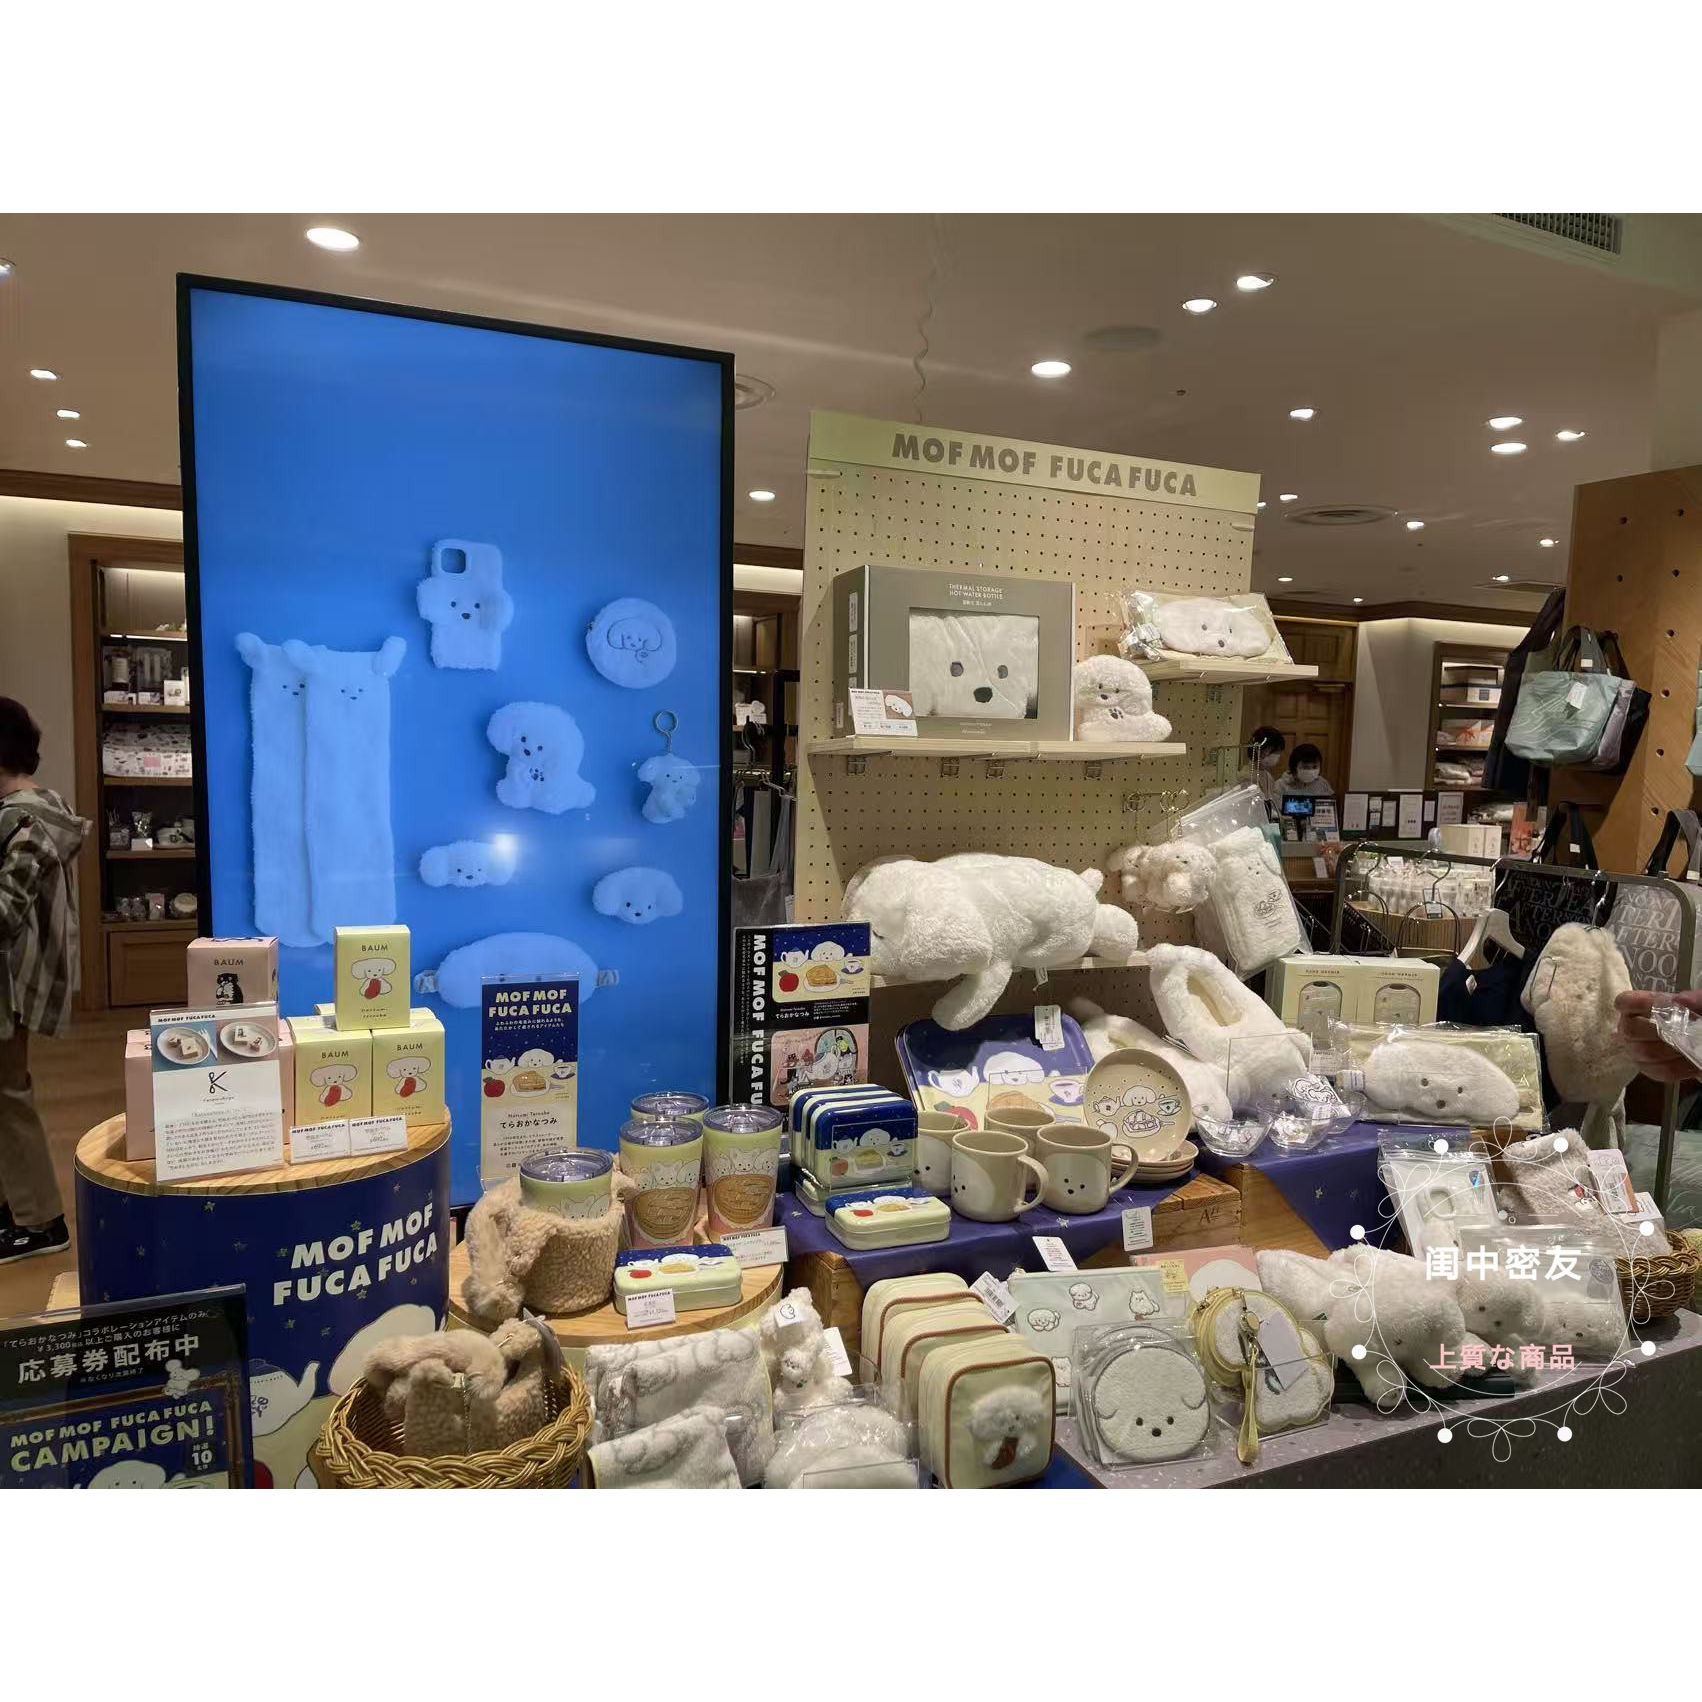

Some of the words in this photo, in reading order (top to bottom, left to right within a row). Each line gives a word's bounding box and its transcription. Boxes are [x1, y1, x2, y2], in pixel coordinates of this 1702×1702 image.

[892, 433, 963, 465] MOF
[969, 444, 1037, 475] MOF
[1050, 455, 1122, 488] FUCA
[1128, 466, 1197, 497] FUCA
[949, 583, 975, 592] THERMAL
[976, 586, 1003, 594] STORAGE
[361, 944, 389, 952] BAUM
[752, 934, 767, 976] MOF
[213, 958, 244, 966] BAUM
[495, 991, 531, 1003] MOF
[532, 989, 567, 1001] MOF
[752, 980, 766, 1022] MOF
[488, 1005, 530, 1018] FUCA
[532, 1002, 572, 1015] FUCA
[775, 1011, 810, 1019] てらおかなつみ
[321, 1051, 349, 1059] BAUM
[396, 1043, 424, 1051] BAUM
[751, 1029, 765, 1078] FUCA
[500, 1117, 557, 1129] てらおかなつみ
[291, 1229, 374, 1269] MOF
[379, 1202, 433, 1248] MOF
[273, 1264, 372, 1306] FUCA
[378, 1231, 438, 1282] FUCA
[18, 1333, 199, 1384] 応募券配布中
[10, 1428, 56, 1448] MOF
[59, 1420, 102, 1439] MOF
[111, 1410, 160, 1430] FUCA
[164, 1400, 213, 1419] FUCA
[10, 1416, 215, 1472] CAMPAIGN!
[192, 1450, 213, 1466] 10
